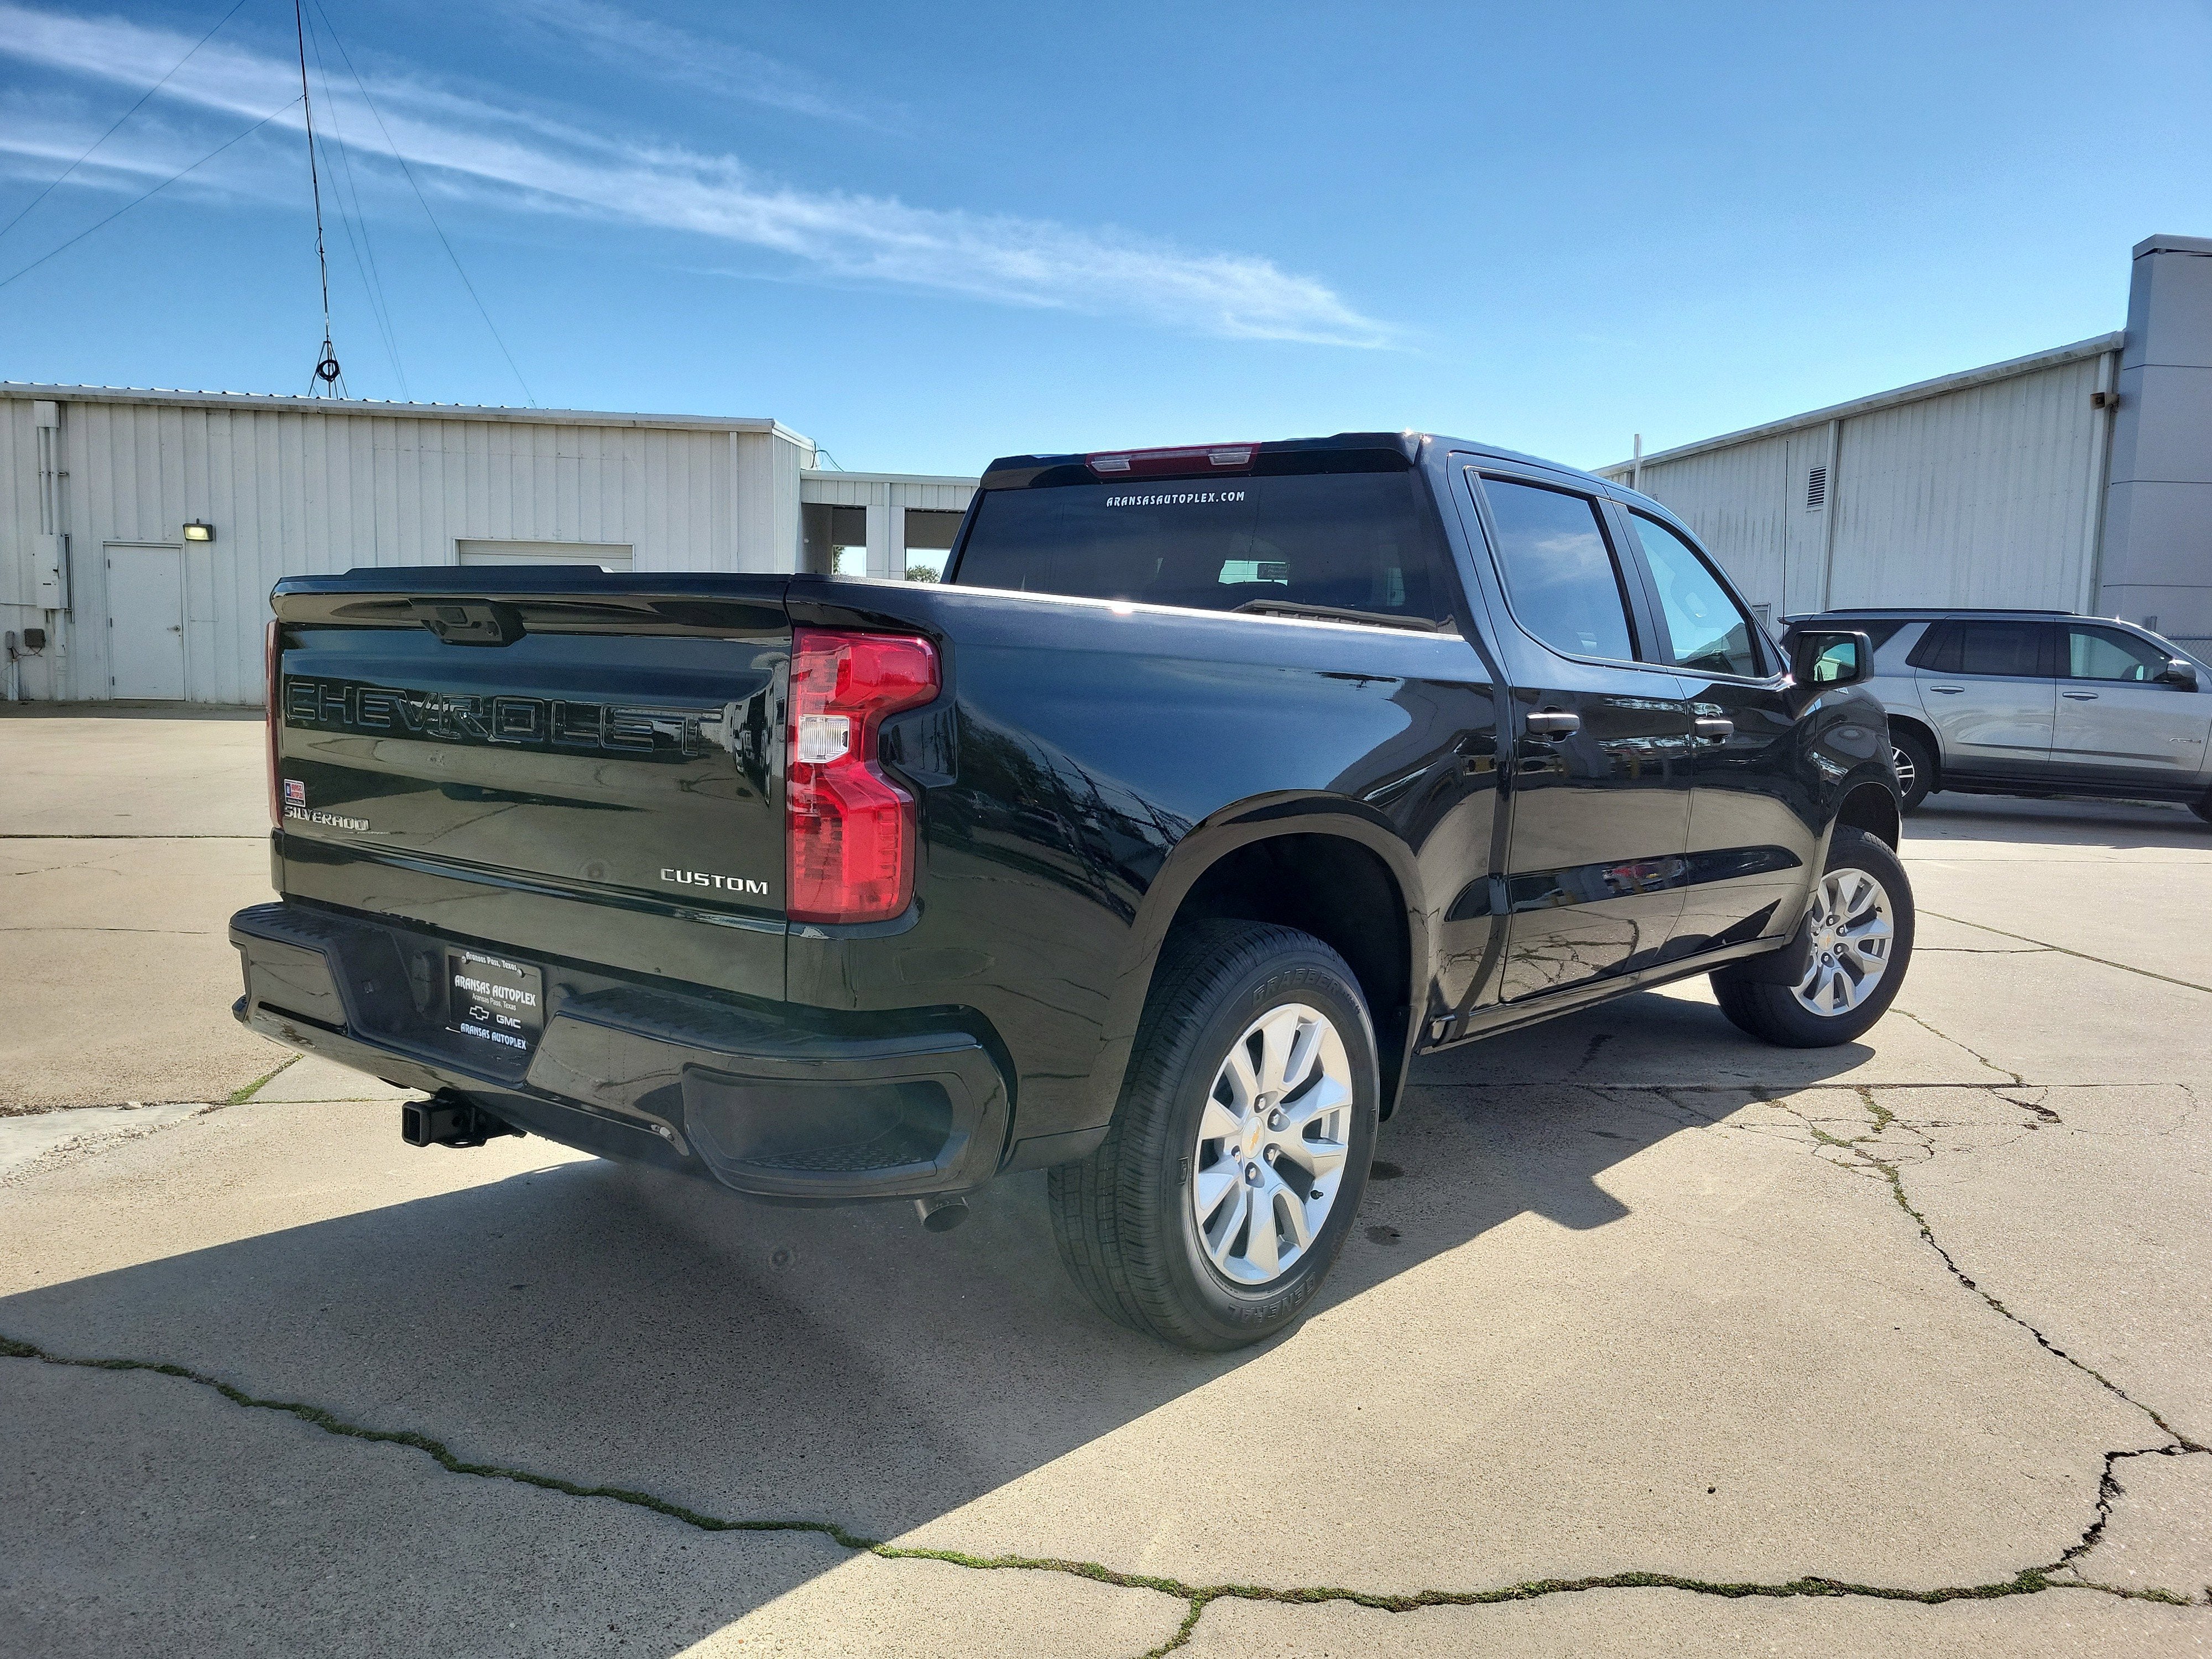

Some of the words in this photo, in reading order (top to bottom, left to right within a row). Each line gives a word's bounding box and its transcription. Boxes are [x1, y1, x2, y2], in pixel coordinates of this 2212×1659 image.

[1107, 492, 1245, 507] ARANSASAUTOPLEX.COM
[287, 681, 722, 757] CHEVROLET
[284, 805, 370, 831] SILVERADO
[661, 868, 769, 895] CUSTOM
[466, 951, 486, 964] Aransas
[487, 957, 501, 968] Pass,
[502, 960, 517, 971] Texas
[455, 974, 490, 995] ARANSAS
[492, 985, 536, 1006] AUTOPLEX
[472, 993, 489, 1004] Aransas
[490, 998, 502, 1008] Pass,
[503, 1001, 517, 1011] Texas
[496, 1014, 521, 1029] GMC
[460, 1023, 490, 1040] ARANSAS
[491, 1031, 526, 1050] AUTOPLEX
